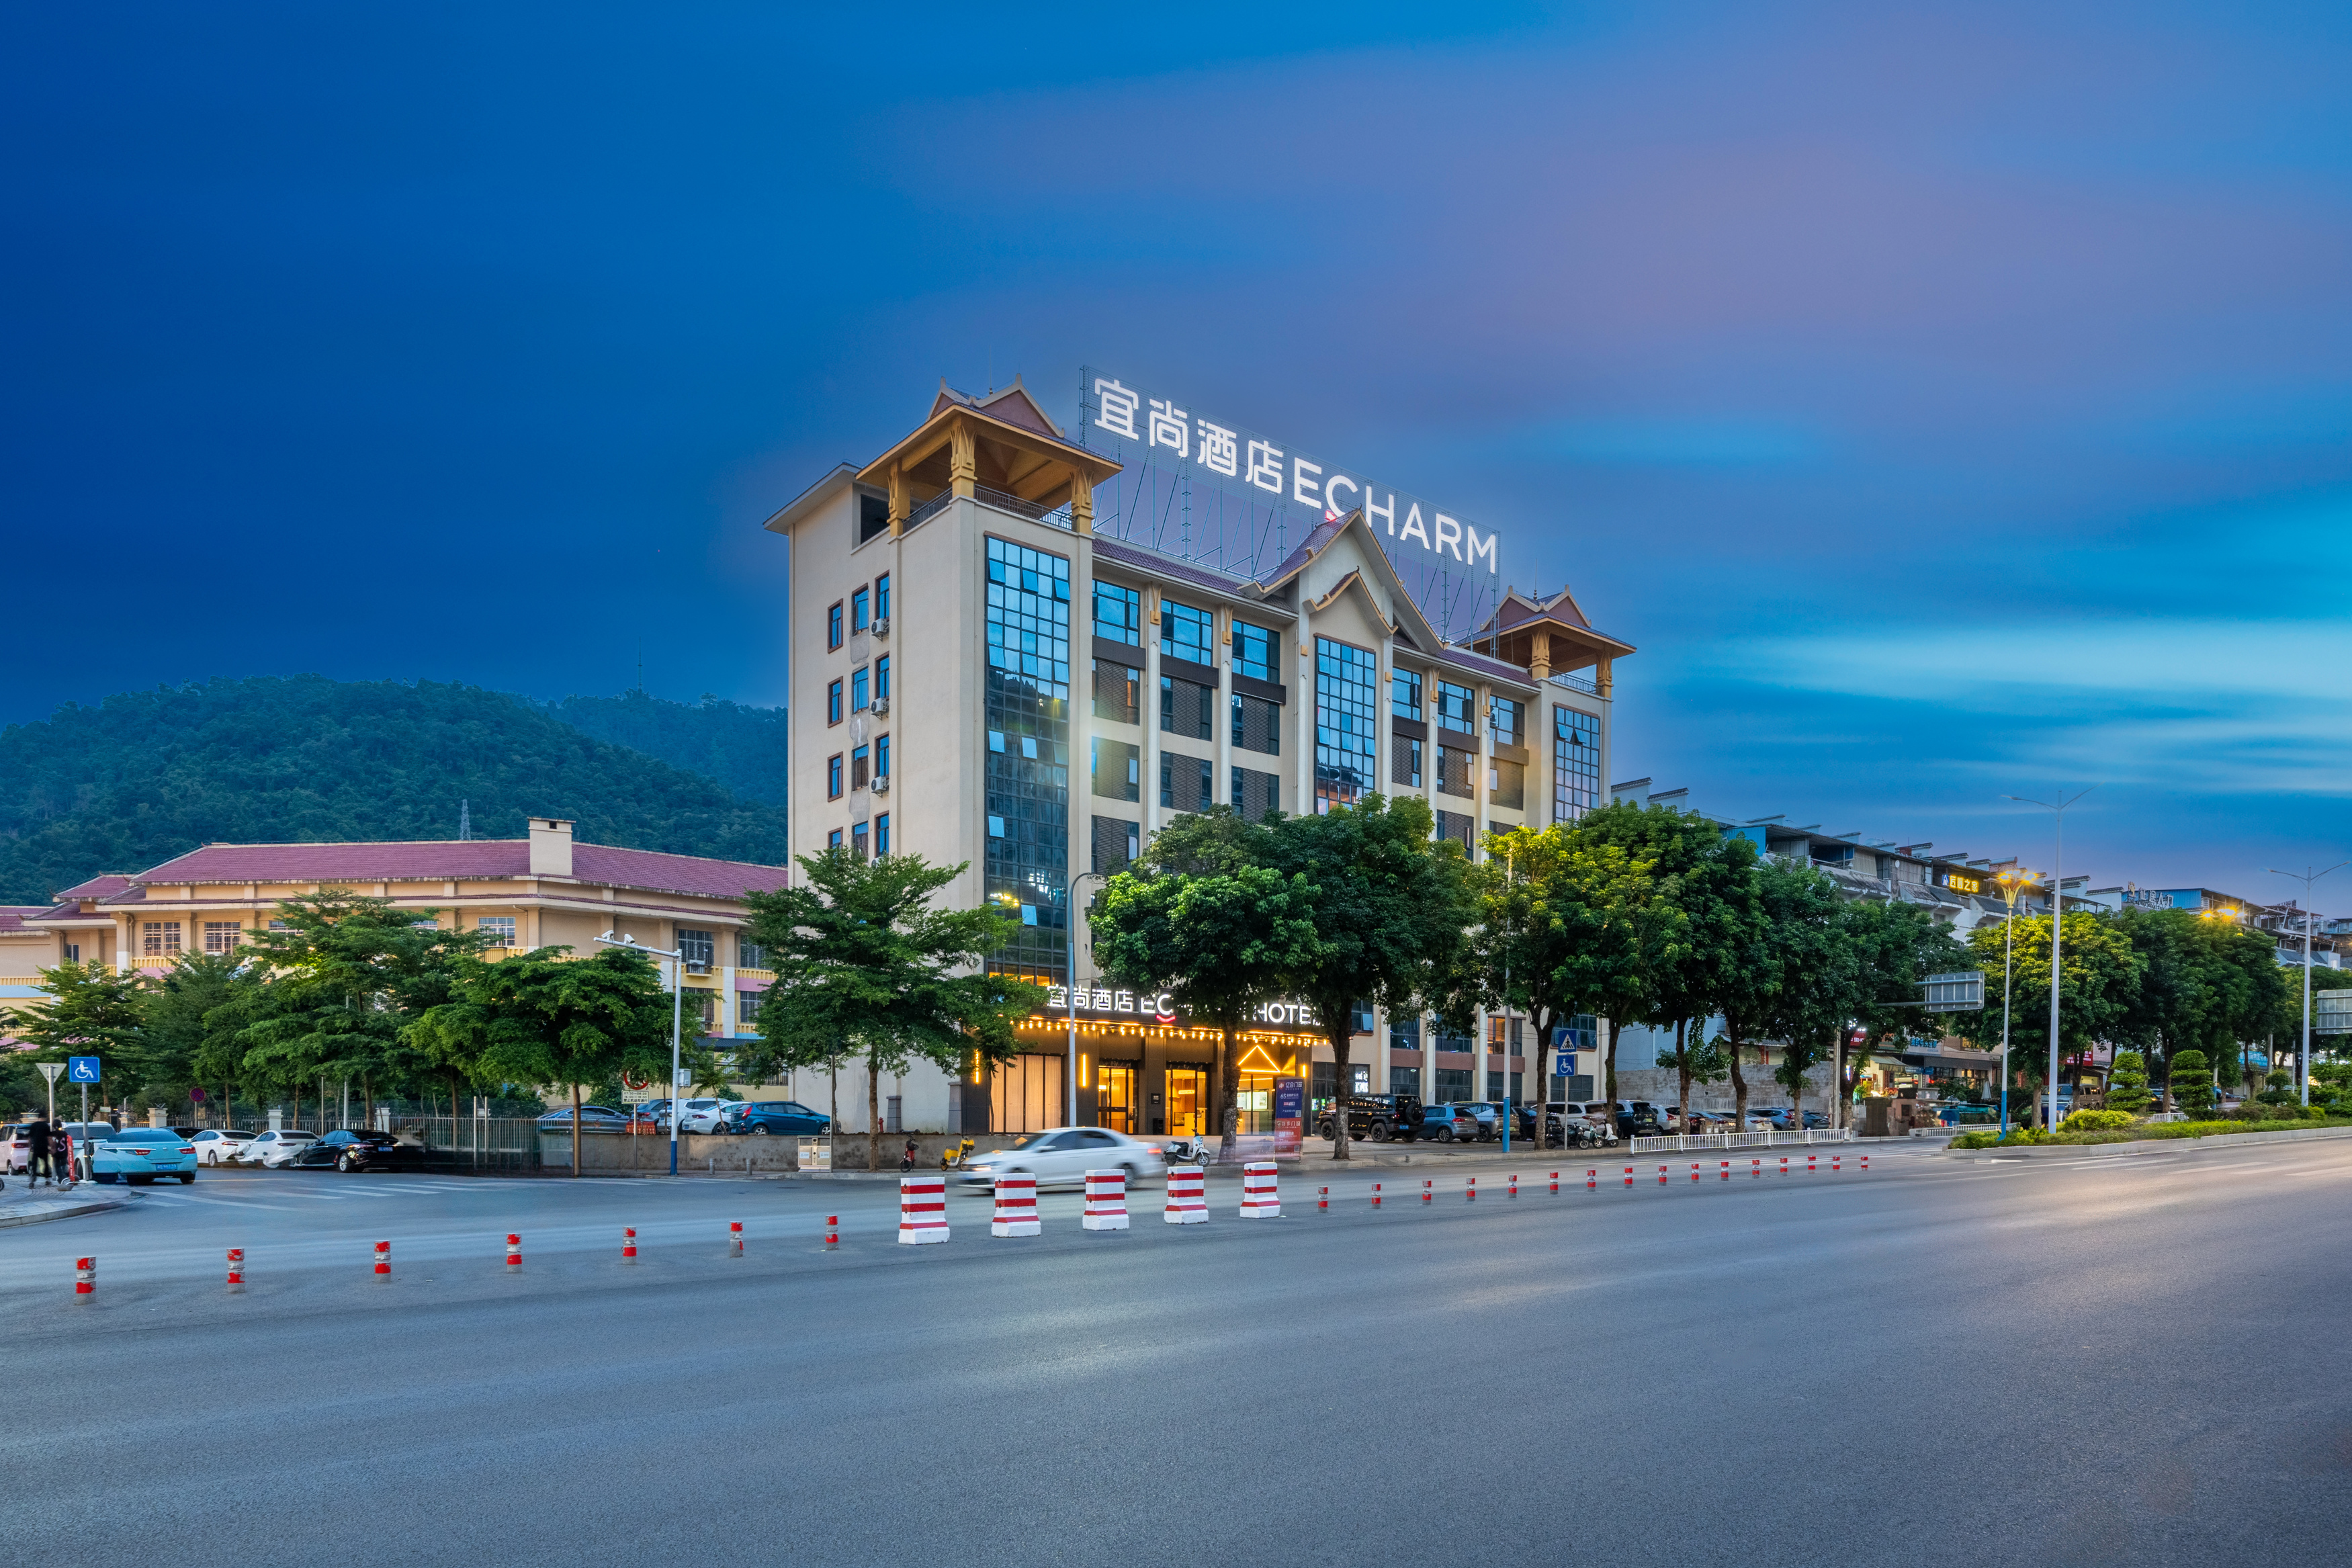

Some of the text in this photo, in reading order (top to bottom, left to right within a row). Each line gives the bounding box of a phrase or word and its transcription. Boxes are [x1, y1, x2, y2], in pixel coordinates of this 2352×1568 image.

[1094, 378, 1496, 574] 宜尚酒店 ECHARM
[1047, 984, 1133, 1012] 宜尚酒店
